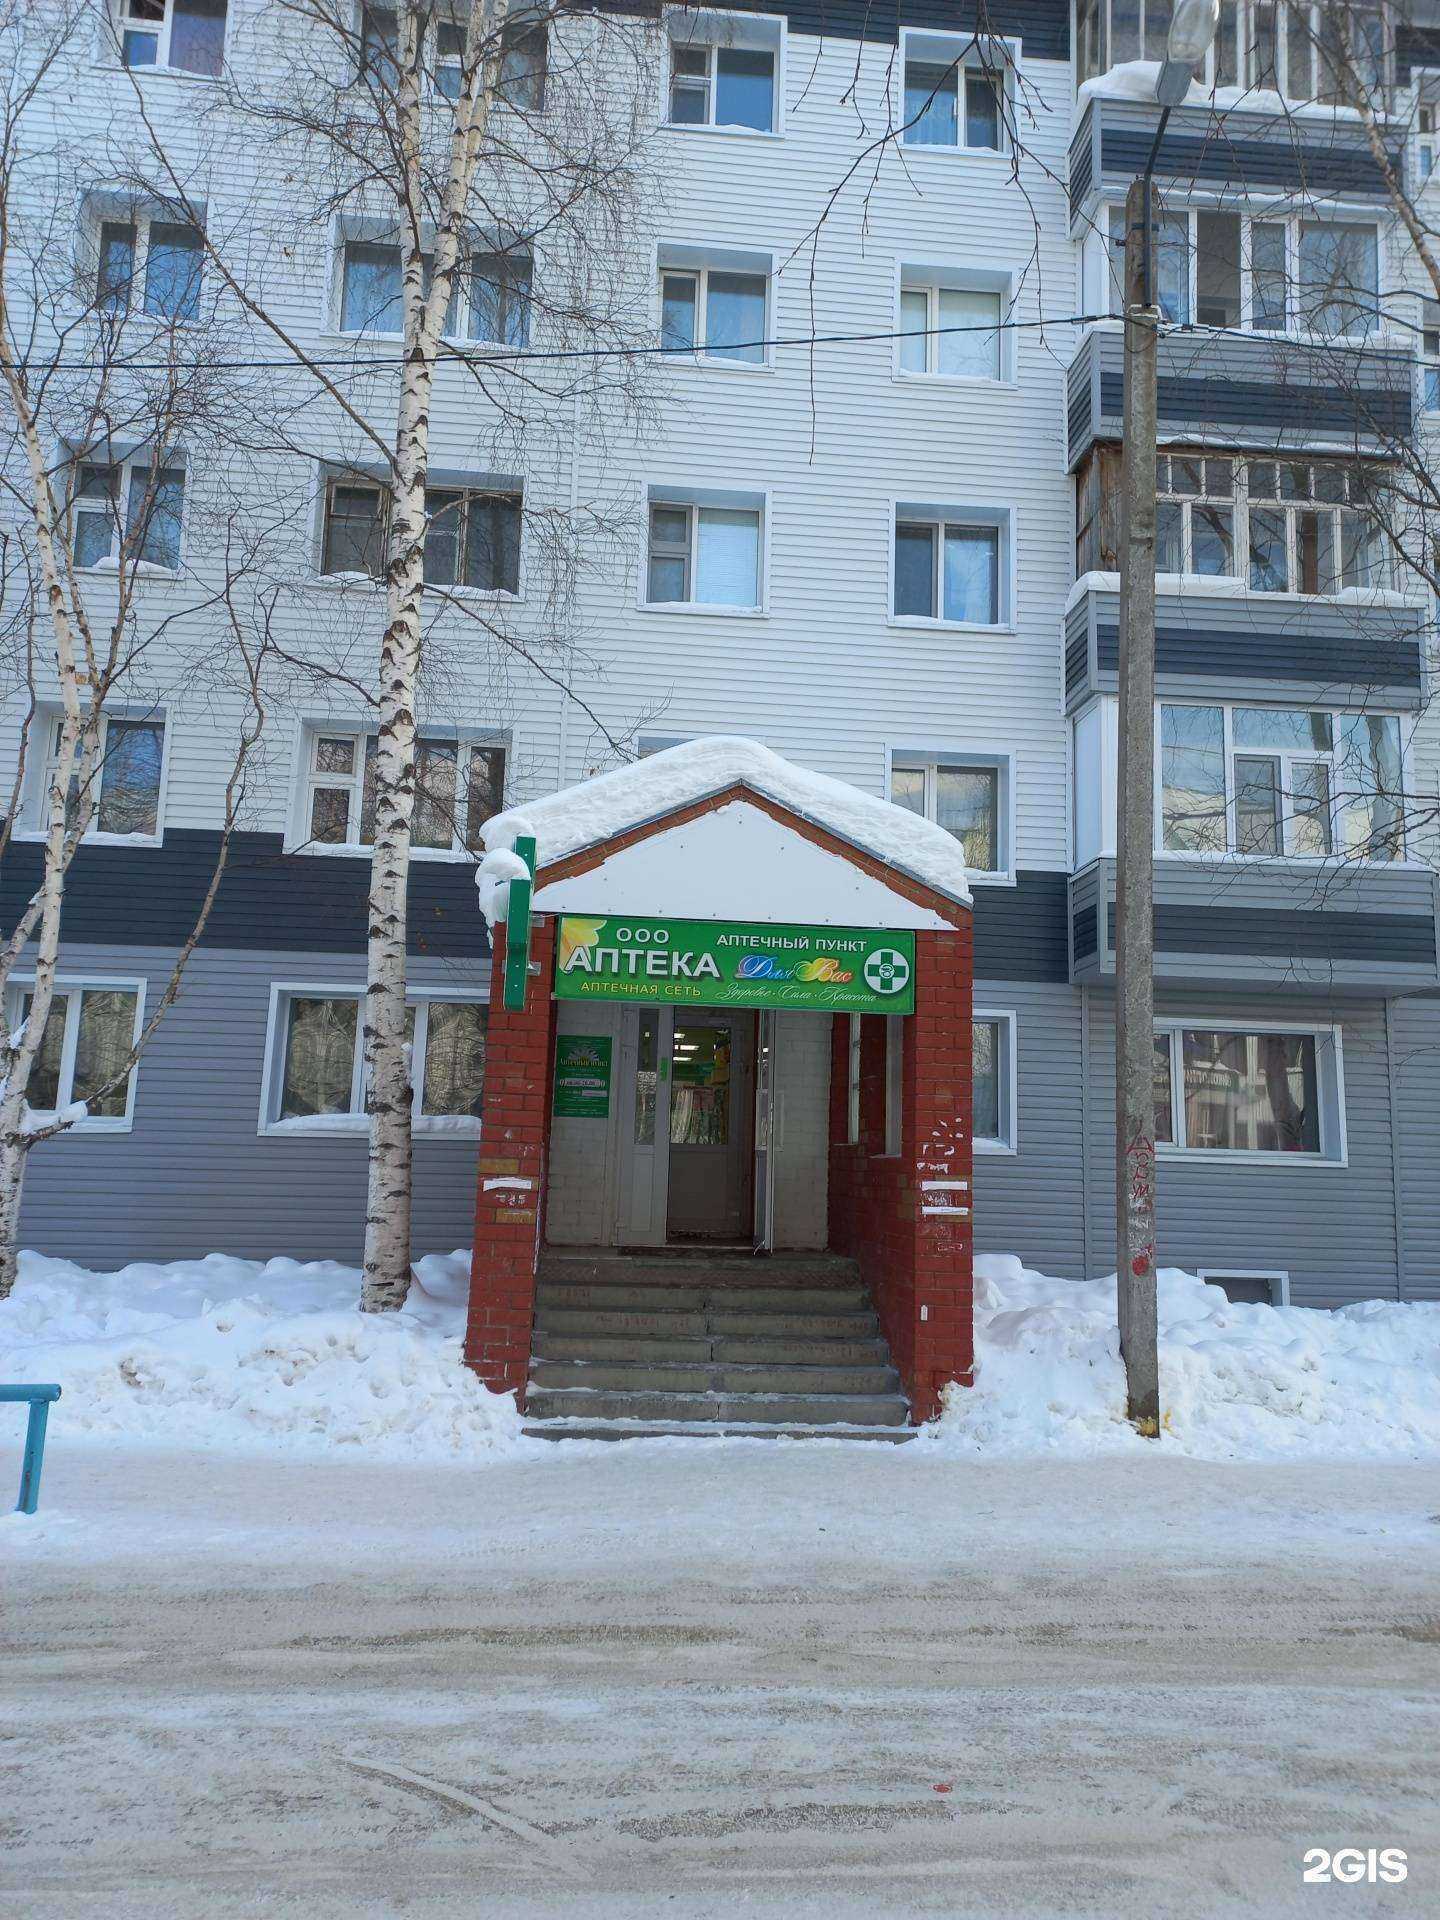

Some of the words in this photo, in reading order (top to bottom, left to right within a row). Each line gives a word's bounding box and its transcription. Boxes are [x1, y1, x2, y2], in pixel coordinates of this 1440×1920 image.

[617, 928, 669, 943] ООО
[717, 934, 809, 950] АПТЕЧНЫЙ
[815, 939, 867, 952] ПУНКТ
[565, 946, 720, 977] АПТЕКА
[794, 957, 853, 982] Вас
[581, 982, 658, 994] АПТЕЧНАЯ
[665, 985, 701, 996] СЕТЬ
